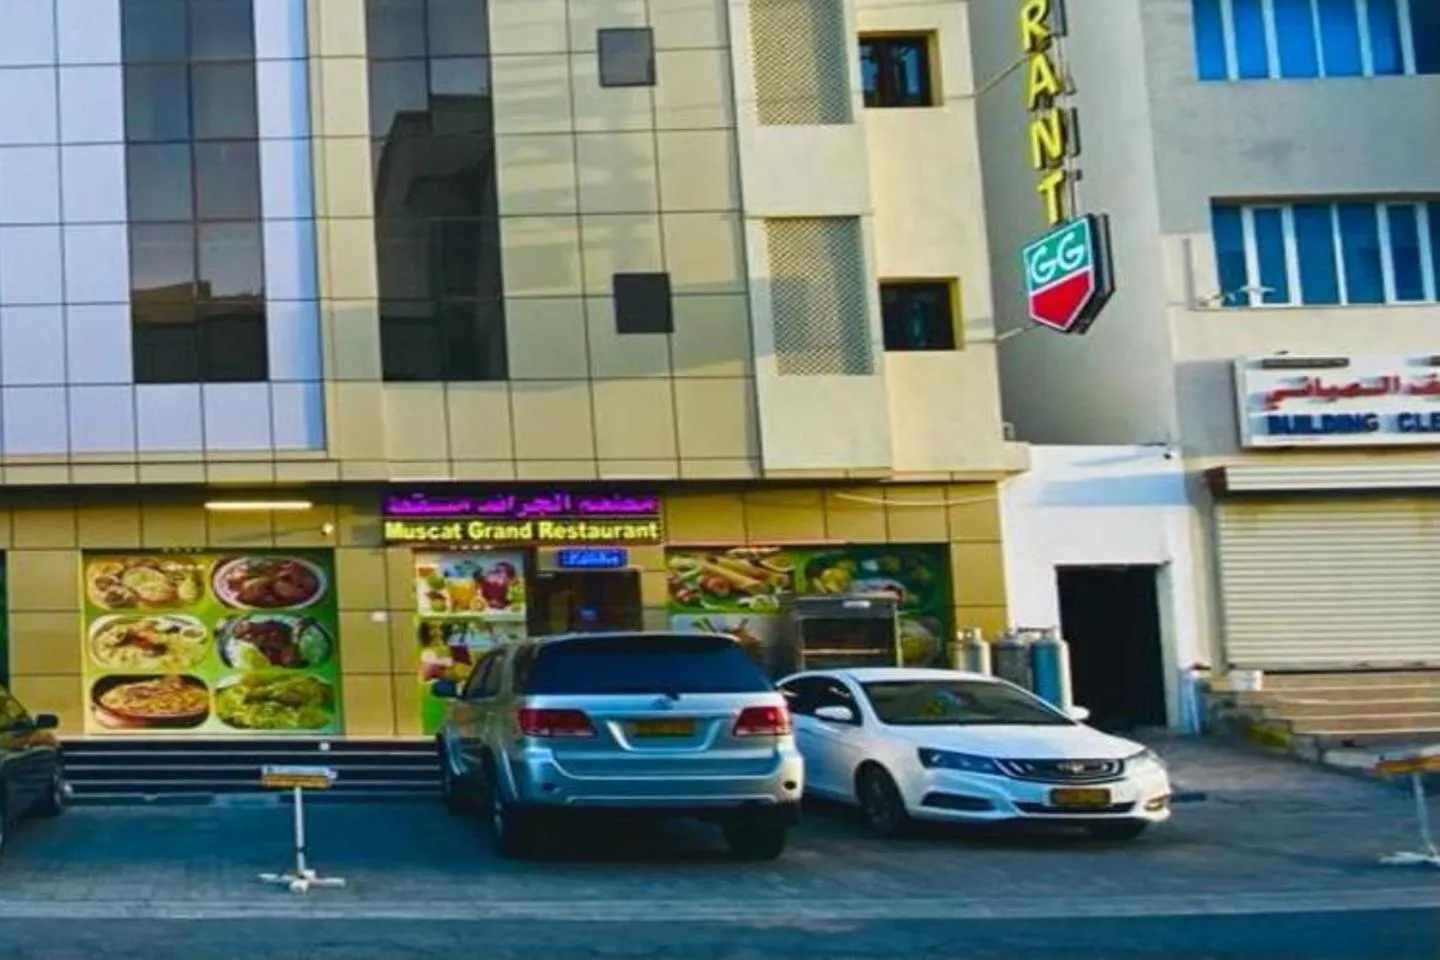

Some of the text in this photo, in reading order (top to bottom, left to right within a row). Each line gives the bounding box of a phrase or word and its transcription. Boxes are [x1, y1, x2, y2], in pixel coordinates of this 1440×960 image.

[385, 521, 659, 539] Muscat Grand Restaurant
